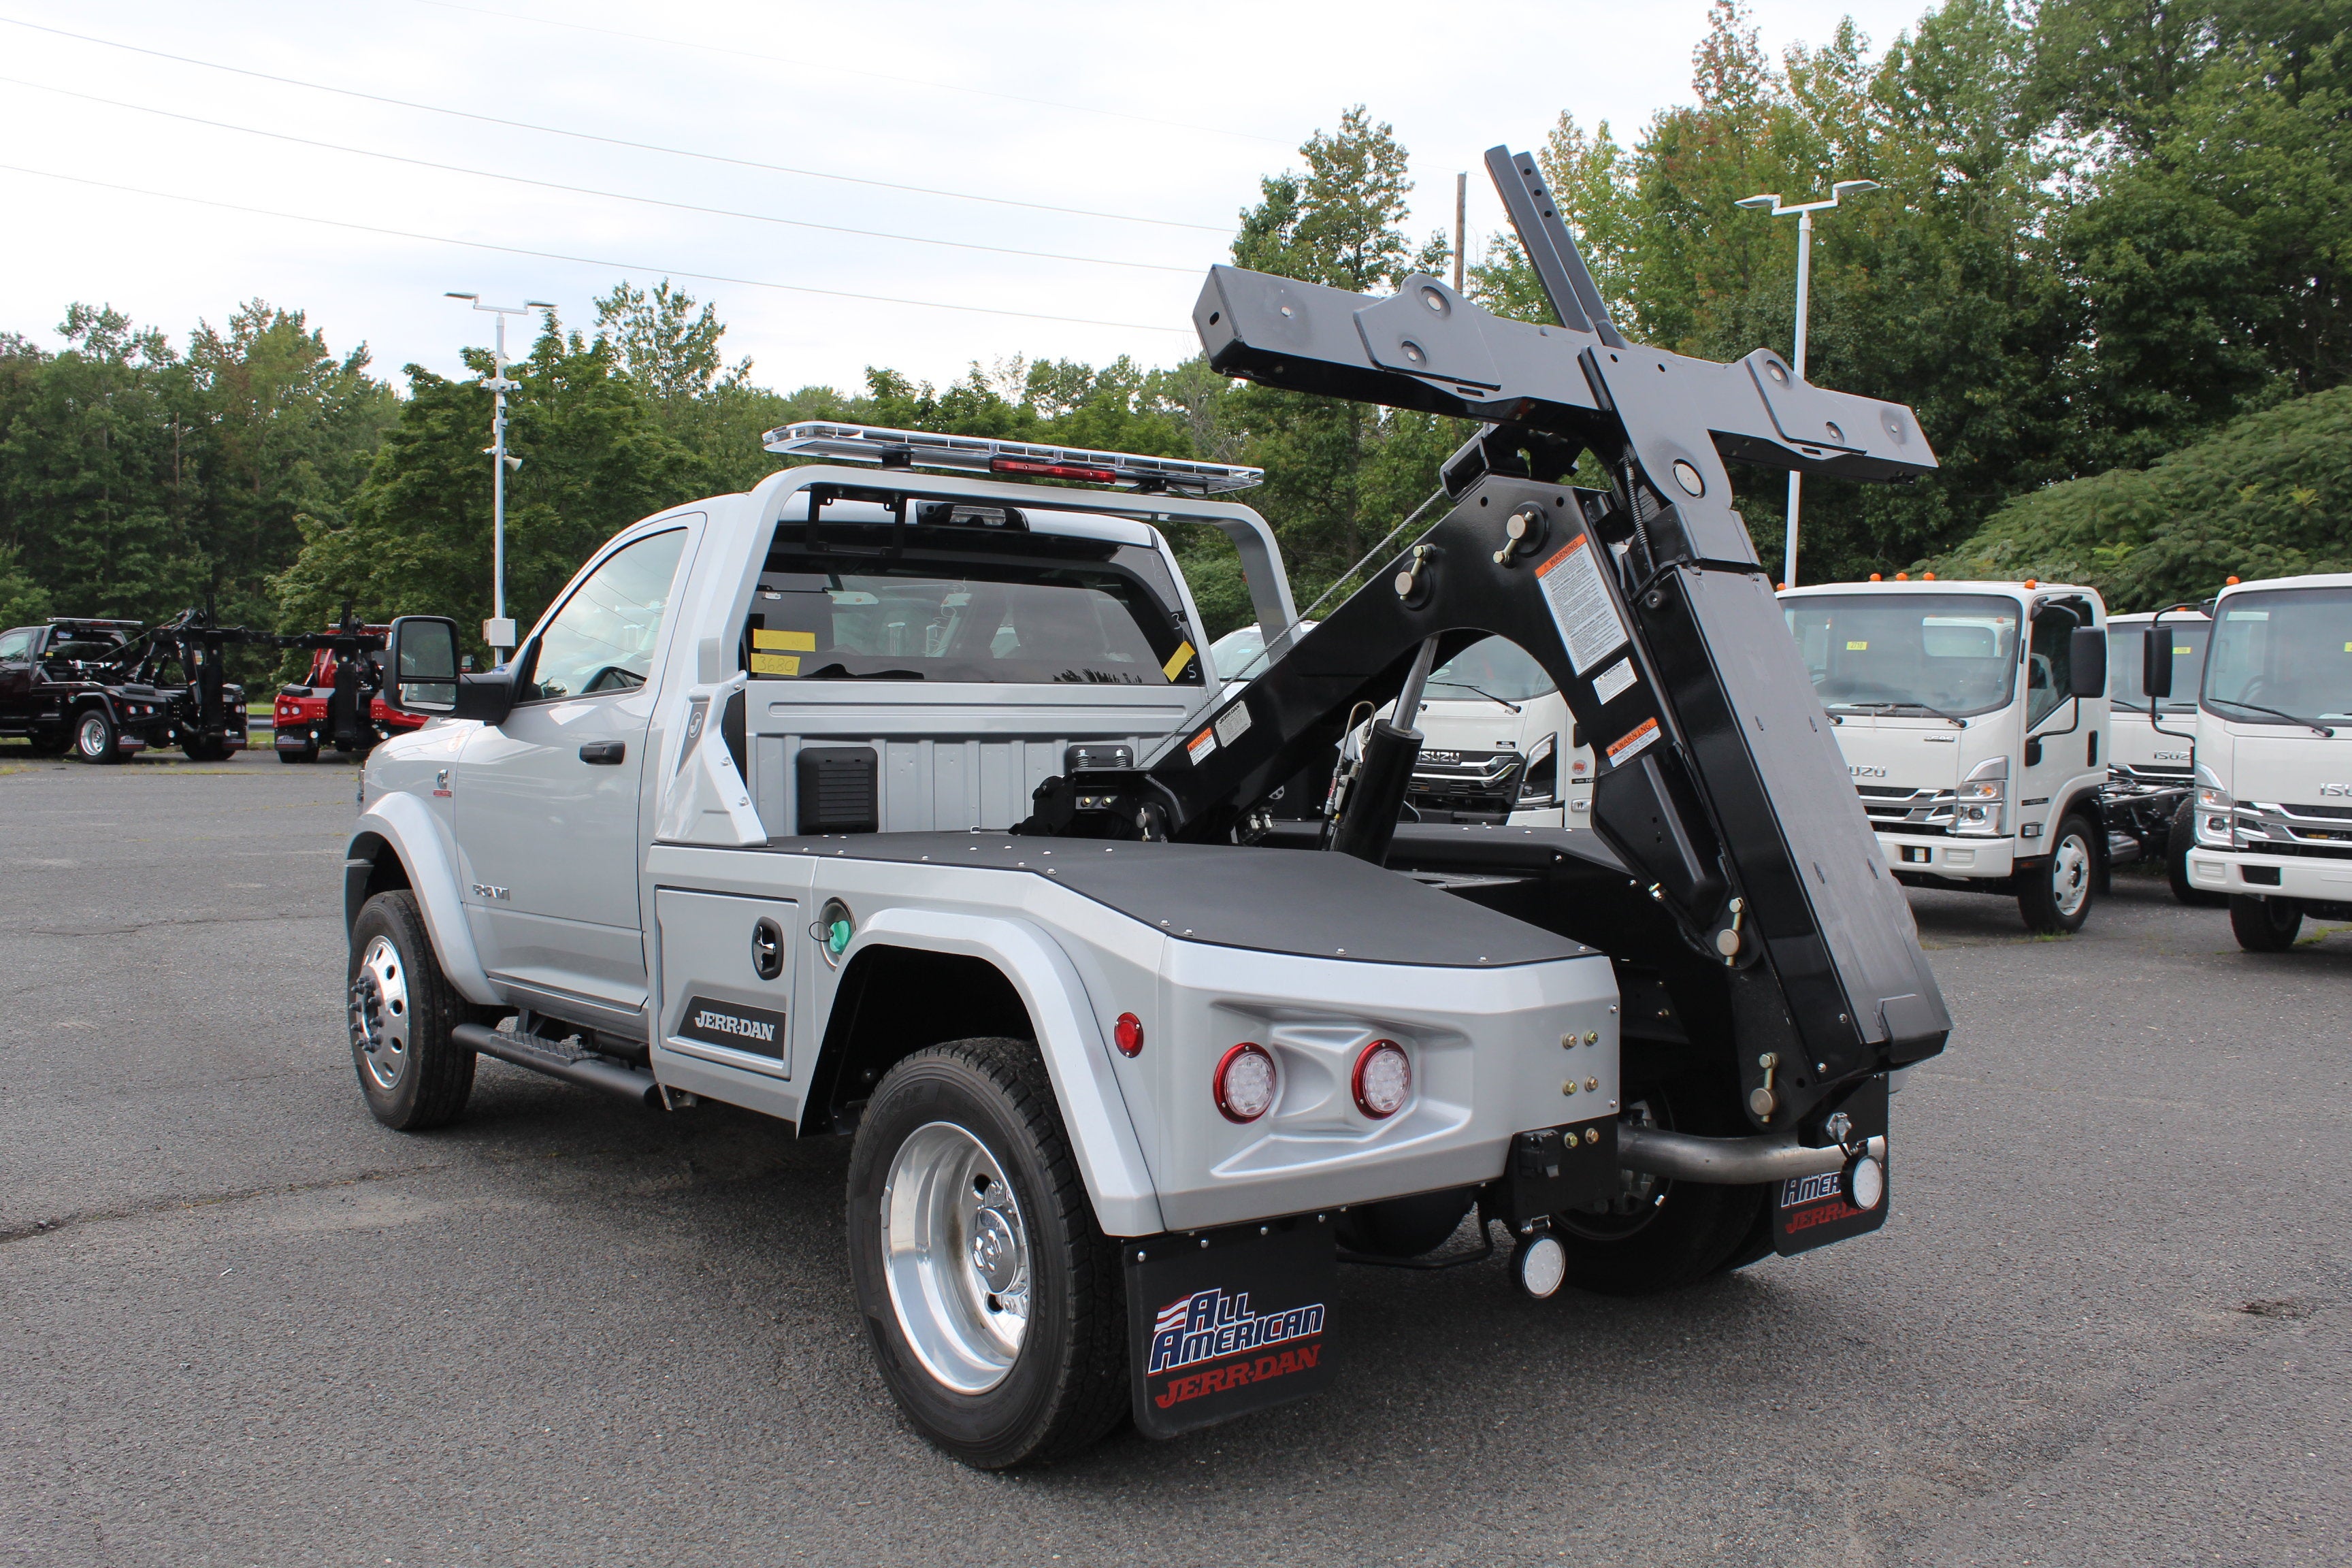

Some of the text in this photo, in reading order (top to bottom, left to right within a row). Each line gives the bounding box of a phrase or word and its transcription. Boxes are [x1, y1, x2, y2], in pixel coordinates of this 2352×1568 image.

[1549, 540, 1578, 566] WARNING
[757, 655, 795, 672] 3680
[1603, 662, 1623, 678] WARNING
[1618, 723, 1651, 748] WARNING
[2154, 751, 2190, 760] ISUZ
[1848, 765, 1886, 777] UZU
[2320, 783, 2352, 796] ISU
[473, 883, 510, 900] RAM
[695, 1011, 774, 1041] JERR-DAN
[1781, 1171, 1842, 1208] AMER
[1786, 1202, 1877, 1234] JERR-
[1184, 1288, 1255, 1336] ALL
[1147, 1303, 1324, 1375] AMERICAN
[1155, 1344, 1322, 1408] JERR-DAN
